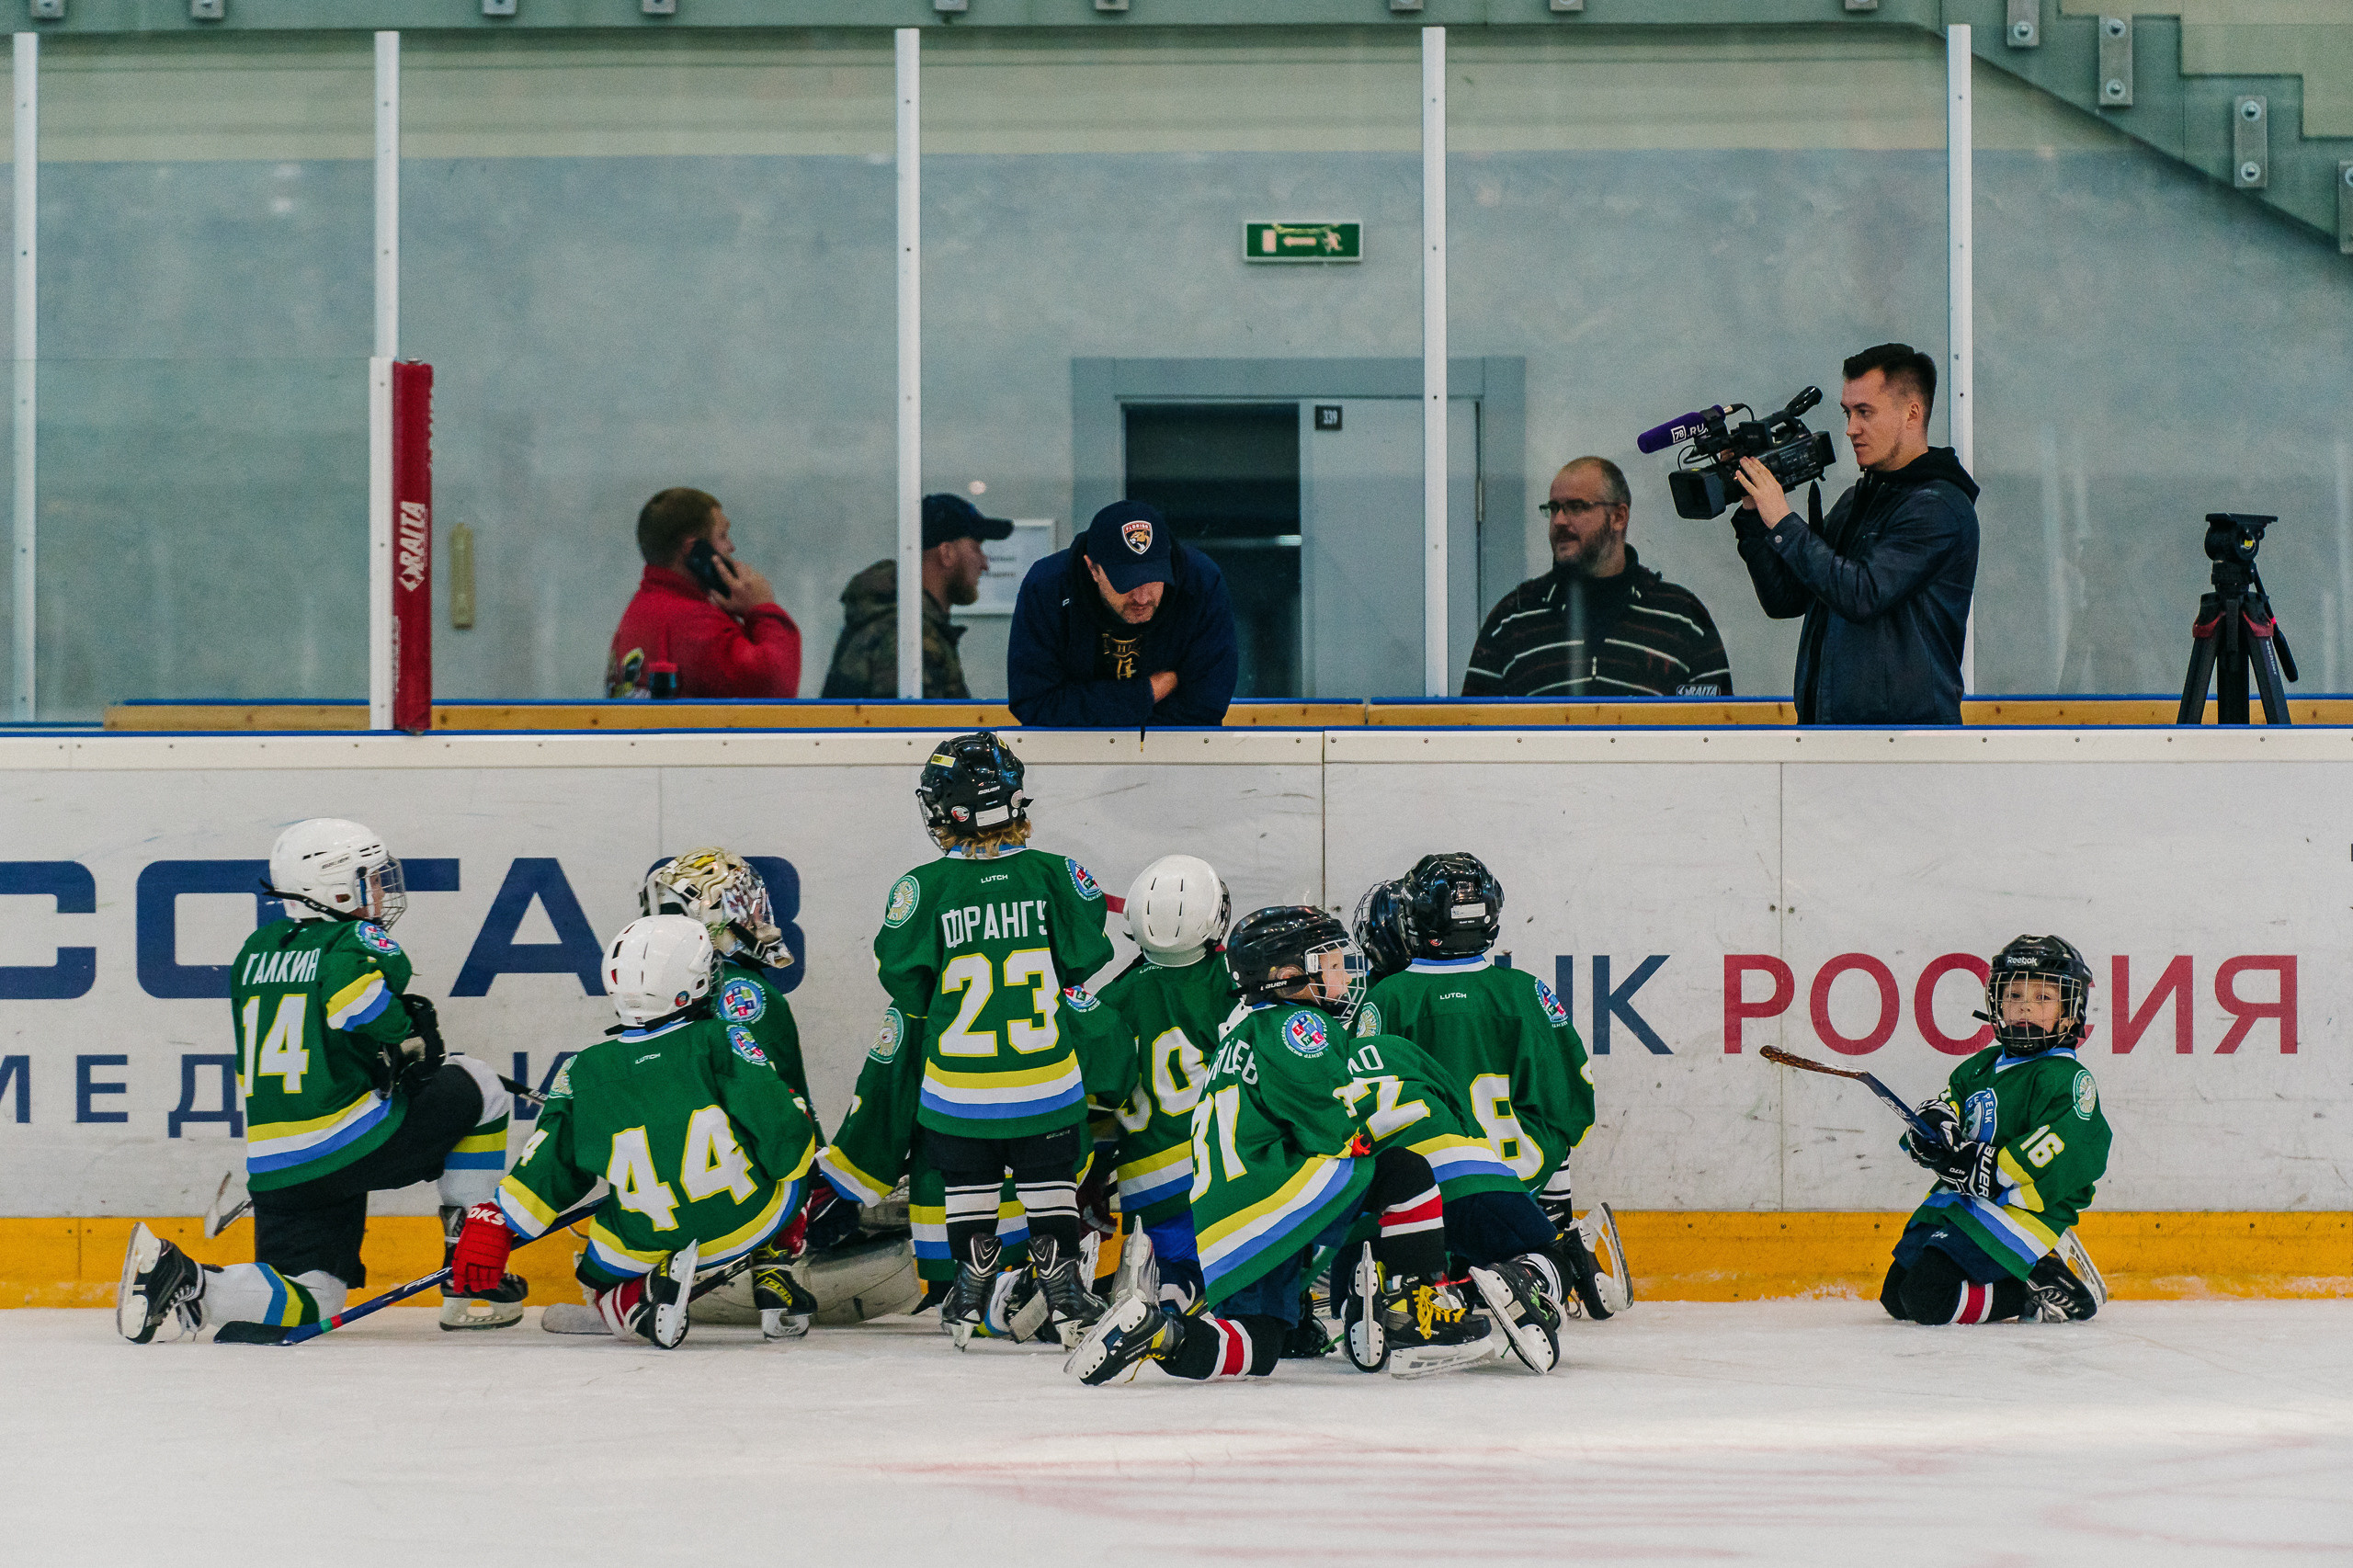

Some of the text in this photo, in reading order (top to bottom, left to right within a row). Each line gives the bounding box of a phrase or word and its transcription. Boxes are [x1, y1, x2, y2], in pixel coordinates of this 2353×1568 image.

[981, 874, 1008, 884] LUTCH
[242, 948, 321, 985] ГАЛКИН
[2007, 956, 2038, 966] Reebok
[938, 947, 1061, 1058] 23
[1439, 992, 1467, 1000] LUTCH
[1723, 952, 2299, 1056] РОСИЯ
[243, 993, 310, 1097] 14
[2019, 1124, 2065, 1168] 16
[607, 1104, 758, 1233] 44
